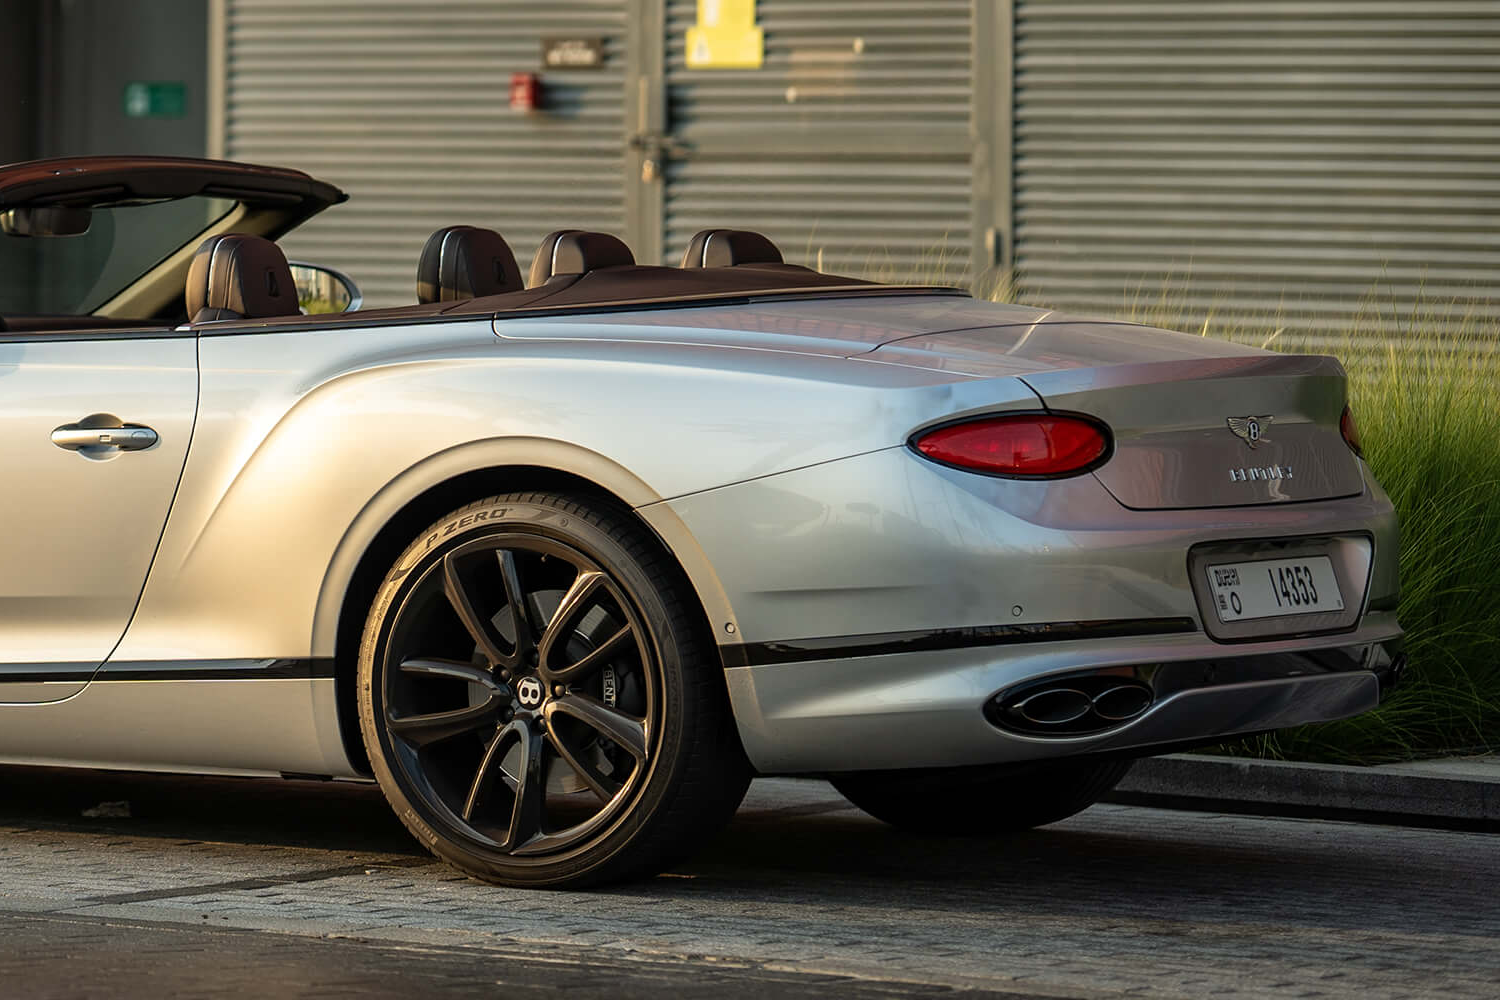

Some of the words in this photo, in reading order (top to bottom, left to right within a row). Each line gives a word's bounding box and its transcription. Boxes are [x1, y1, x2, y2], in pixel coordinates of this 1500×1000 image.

[425, 533, 439, 549] P
[444, 508, 508, 537] ZERO
[1268, 565, 1318, 607] 14353
[519, 680, 541, 705] B
